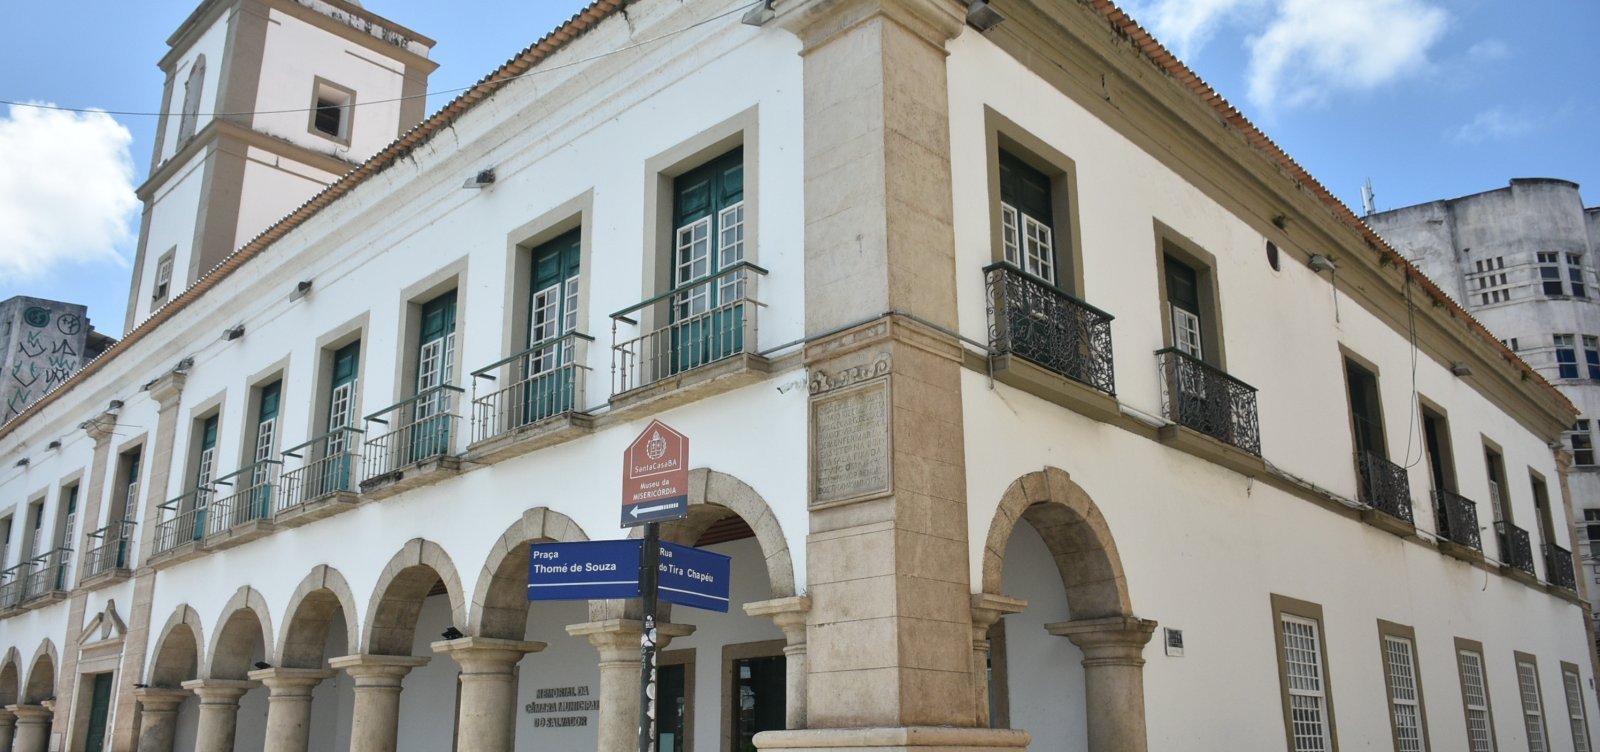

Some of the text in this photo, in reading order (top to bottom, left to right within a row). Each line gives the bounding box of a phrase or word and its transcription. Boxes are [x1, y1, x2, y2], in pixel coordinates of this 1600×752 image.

[634, 458, 677, 474] SantaCasaBA
[632, 487, 676, 500] MISERICÓRDIA
[534, 550, 559, 560] Praça
[659, 547, 672, 558] Rua
[534, 562, 616, 574] Thomé de Souza
[659, 564, 714, 583] do Tira Chapéu
